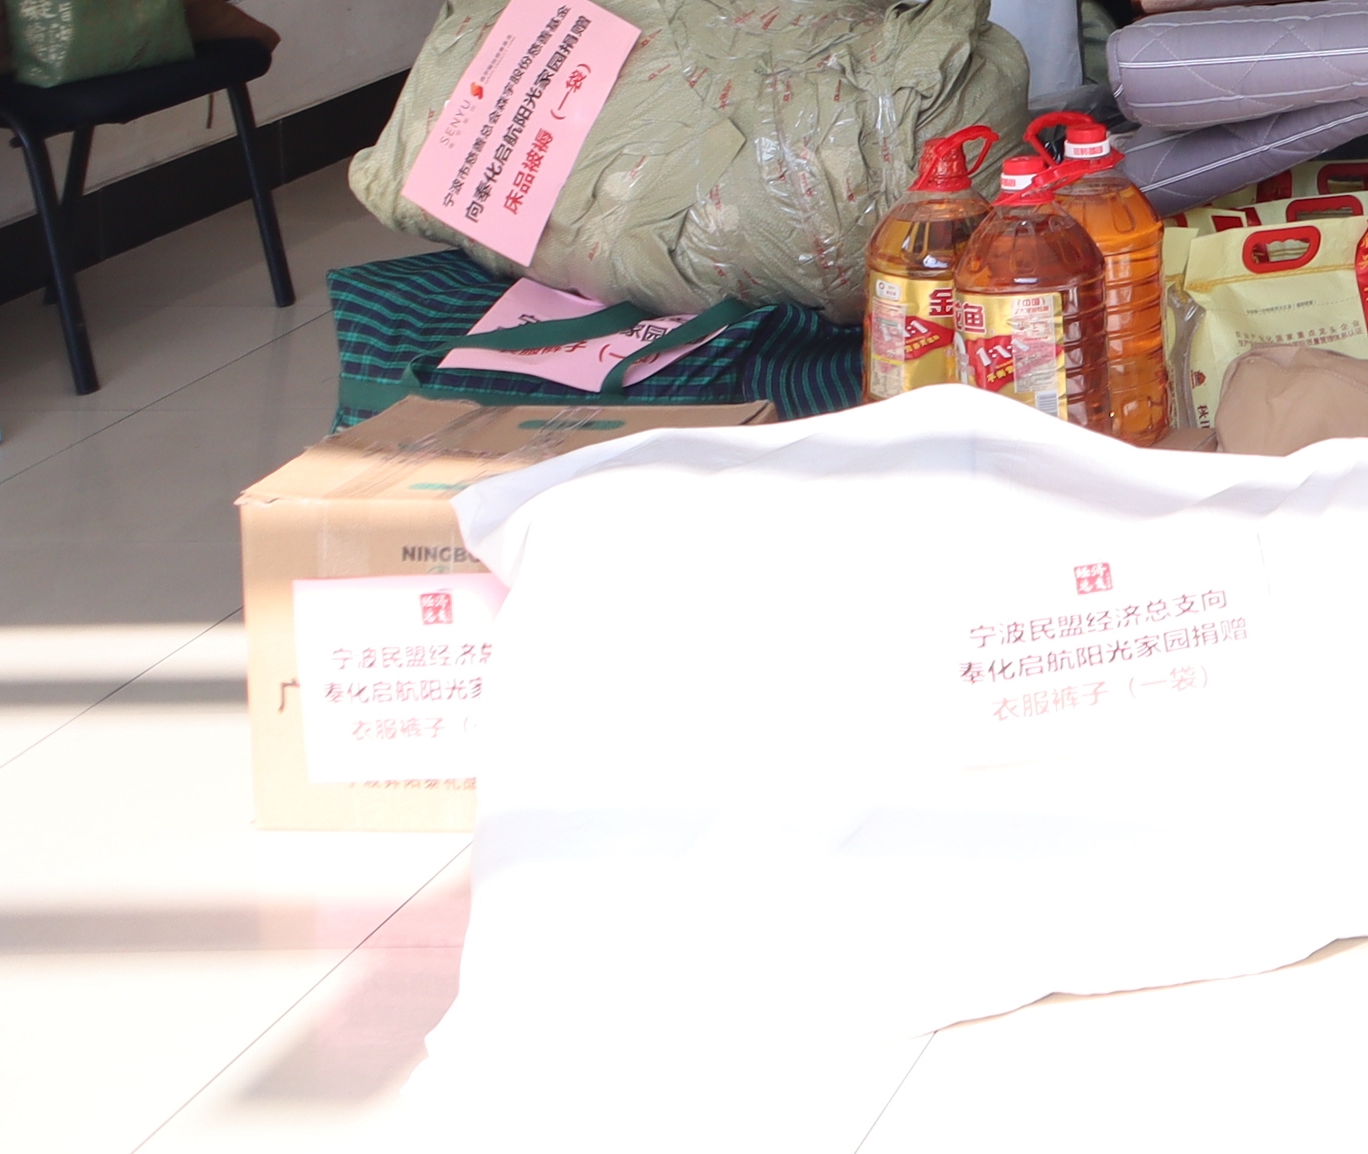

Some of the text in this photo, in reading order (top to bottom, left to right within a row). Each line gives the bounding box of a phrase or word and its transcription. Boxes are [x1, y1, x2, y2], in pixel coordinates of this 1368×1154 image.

[440, 99, 471, 146] SENYU
[465, 15, 593, 224] 向奉化启航阳光家园捐赠
[503, 63, 593, 215] 床品被褥（一袋）
[958, 616, 1249, 685] 奉化启航阳光家园捐赠
[969, 588, 1228, 649] 宁波民盟经济总支向
[992, 664, 1209, 722] 衣服裤子（一袋）
